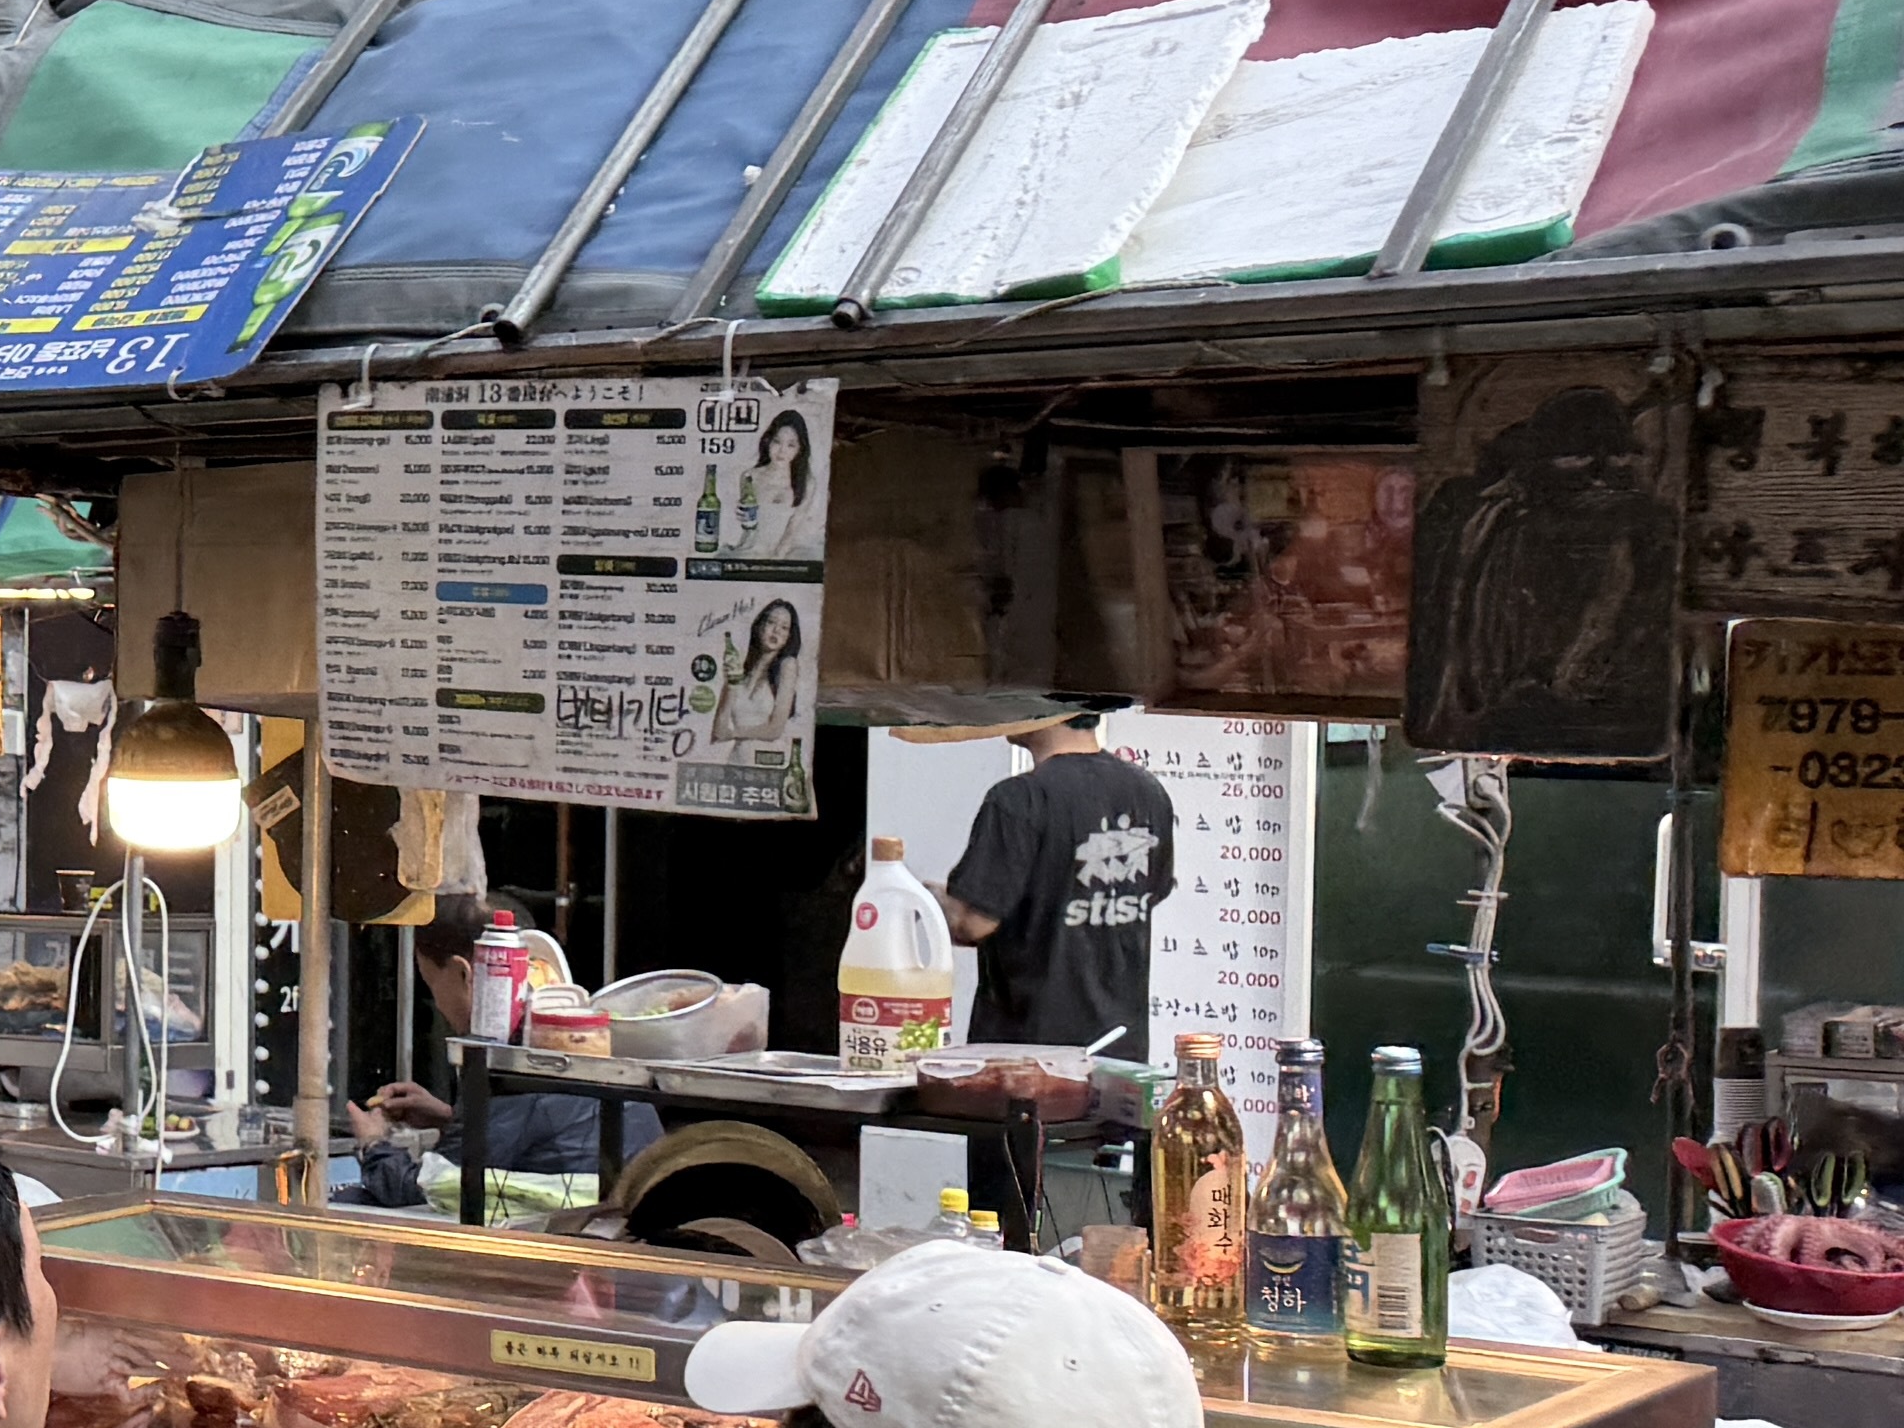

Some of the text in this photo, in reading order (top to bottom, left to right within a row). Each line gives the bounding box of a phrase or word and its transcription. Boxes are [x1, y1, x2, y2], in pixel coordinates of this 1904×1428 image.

[106, 334, 191, 374] 13
[478, 382, 503, 404] 13
[1223, 720, 1286, 737] 20,000
[1221, 782, 1284, 799] 26,000
[1220, 845, 1283, 862] 20,000
[1218, 909, 1282, 926] 20,000
[1216, 970, 1280, 989] 20,000
[1207, 1183, 1234, 1257] 매화수
[1260, 1285, 1307, 1315] 청하
